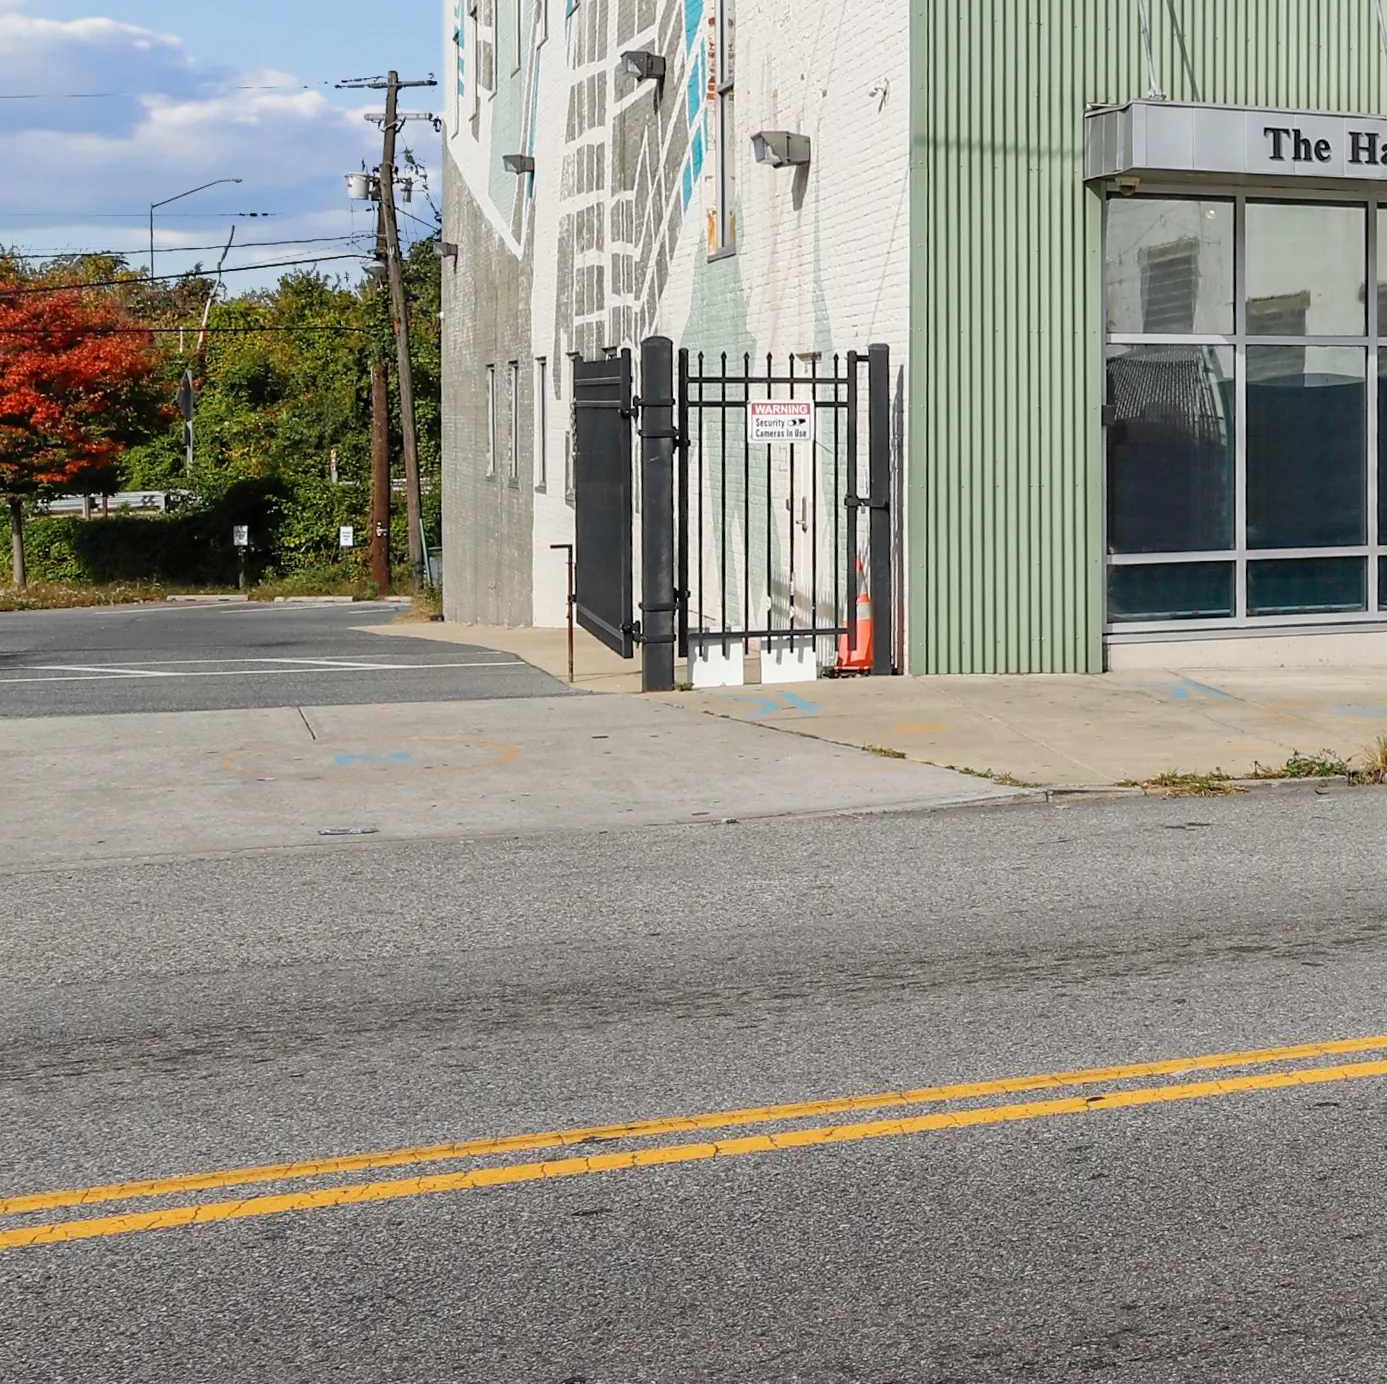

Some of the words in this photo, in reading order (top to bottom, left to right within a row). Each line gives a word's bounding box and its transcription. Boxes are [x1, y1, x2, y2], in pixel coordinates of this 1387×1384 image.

[1264, 127, 1331, 162] The
[755, 404, 808, 414] WARNING
[756, 418, 785, 429] Security
[756, 428, 785, 438] Cameras
[795, 428, 807, 438] Use
